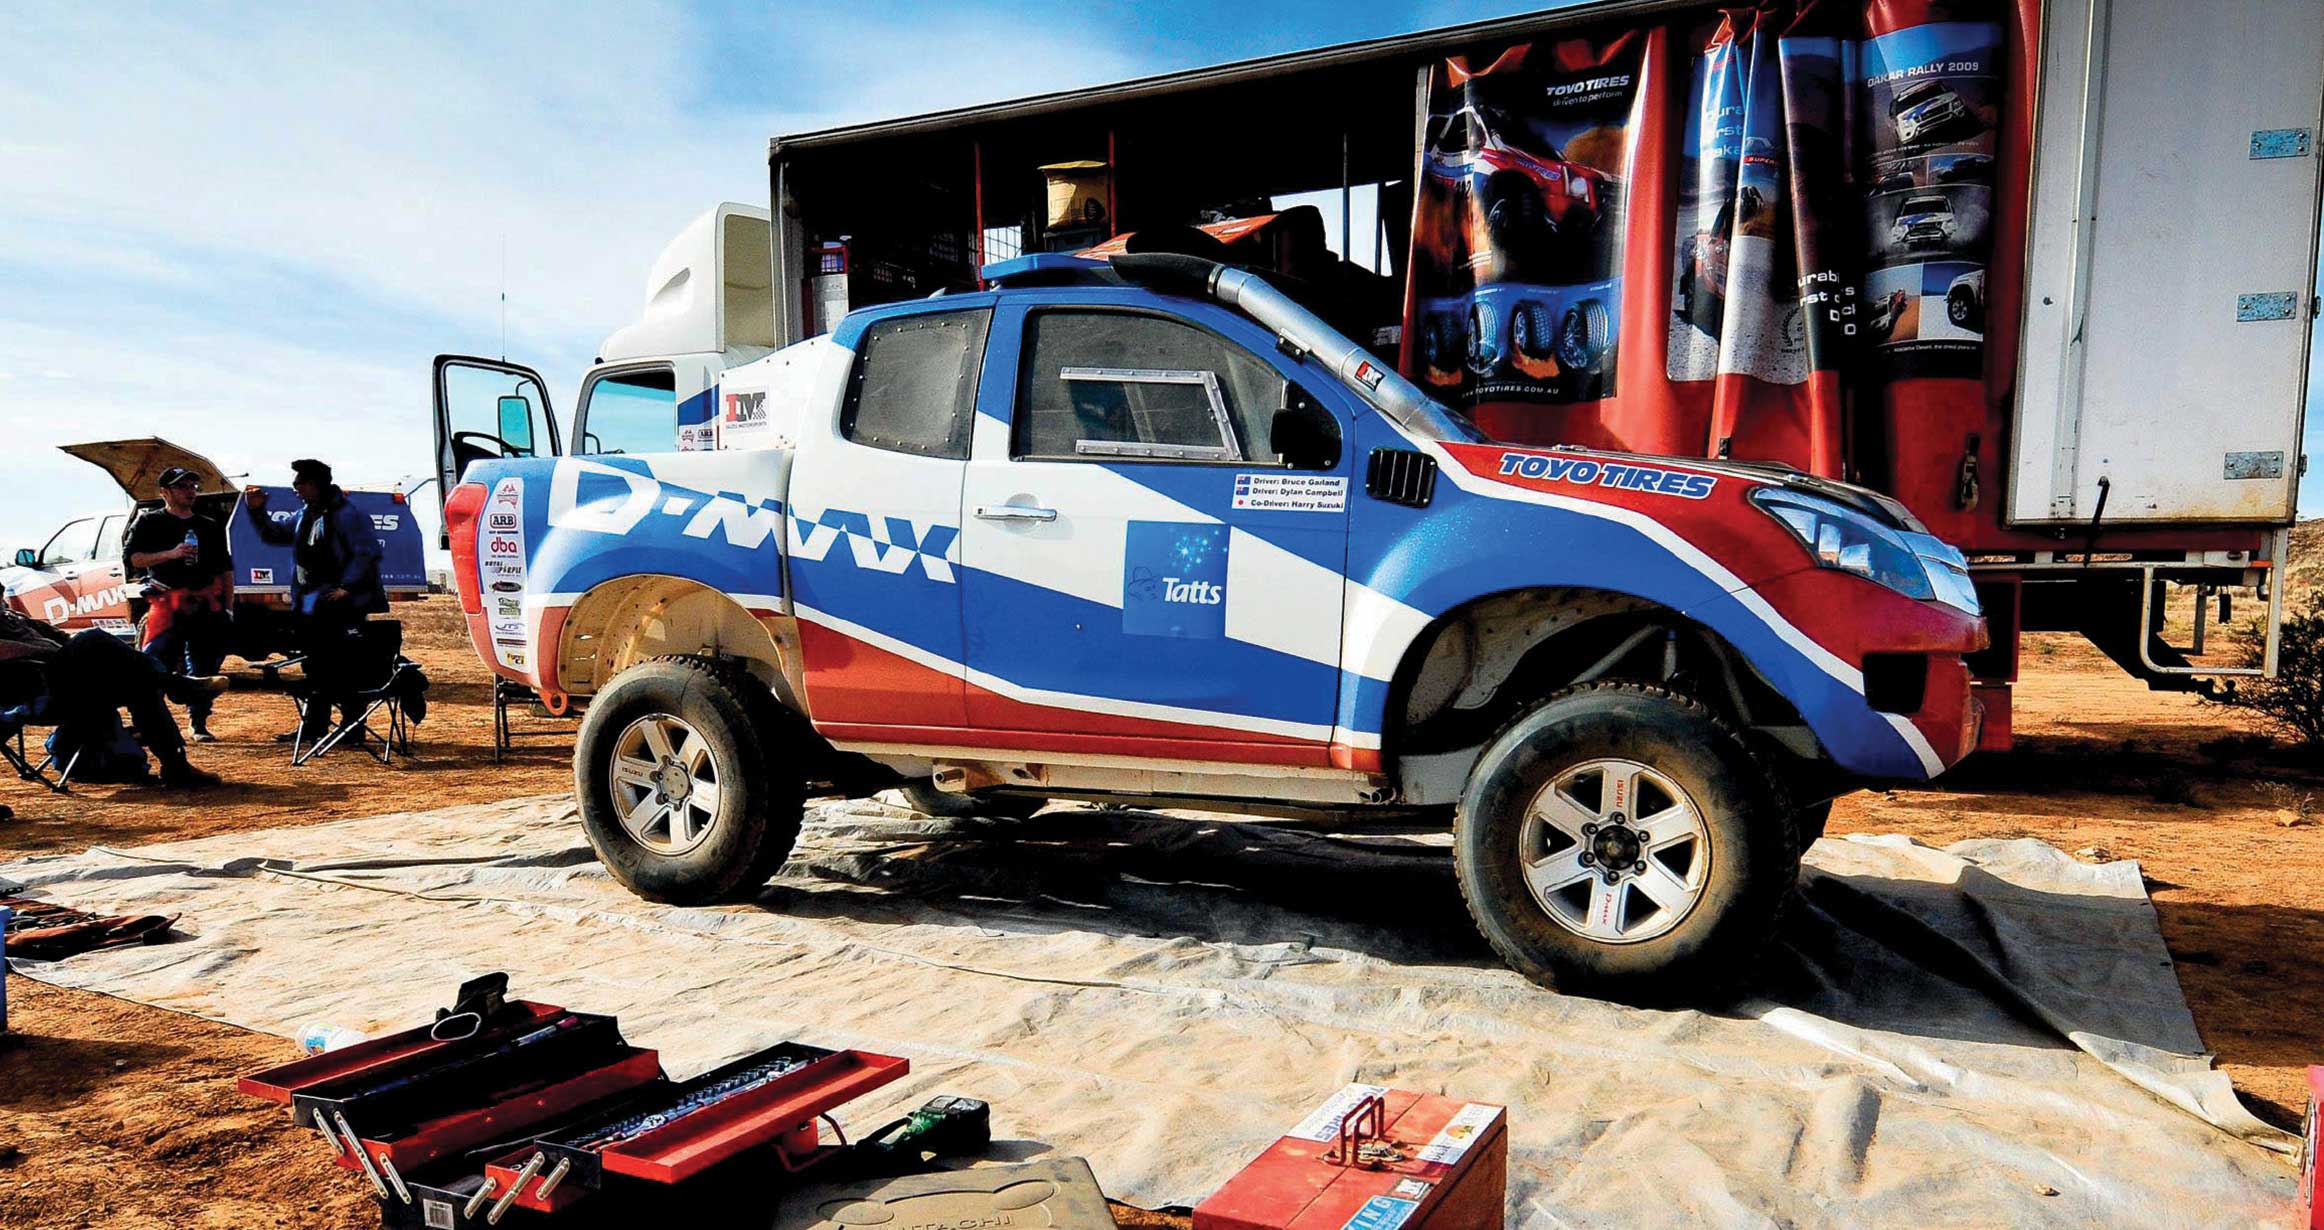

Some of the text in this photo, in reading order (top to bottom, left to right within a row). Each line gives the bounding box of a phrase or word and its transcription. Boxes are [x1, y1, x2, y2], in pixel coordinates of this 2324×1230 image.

[1546, 75, 1630, 96] TOYO TIRES
[1867, 62, 1979, 88] DAKAR RALLY 2009
[1253, 477, 1340, 487] Driver: Bruce Garland
[1499, 452, 1718, 500] TOYO TIRES
[1252, 487, 1343, 497] Driver: Dylan Campbell
[1250, 499, 1343, 509] Co-Driver: Harry Suzuki
[493, 515, 514, 526] ARB
[548, 457, 960, 584] D-MAX
[491, 536, 517, 553] dba
[1162, 576, 1223, 605] Tatts
[1616, 780, 1624, 808] ISUZU
